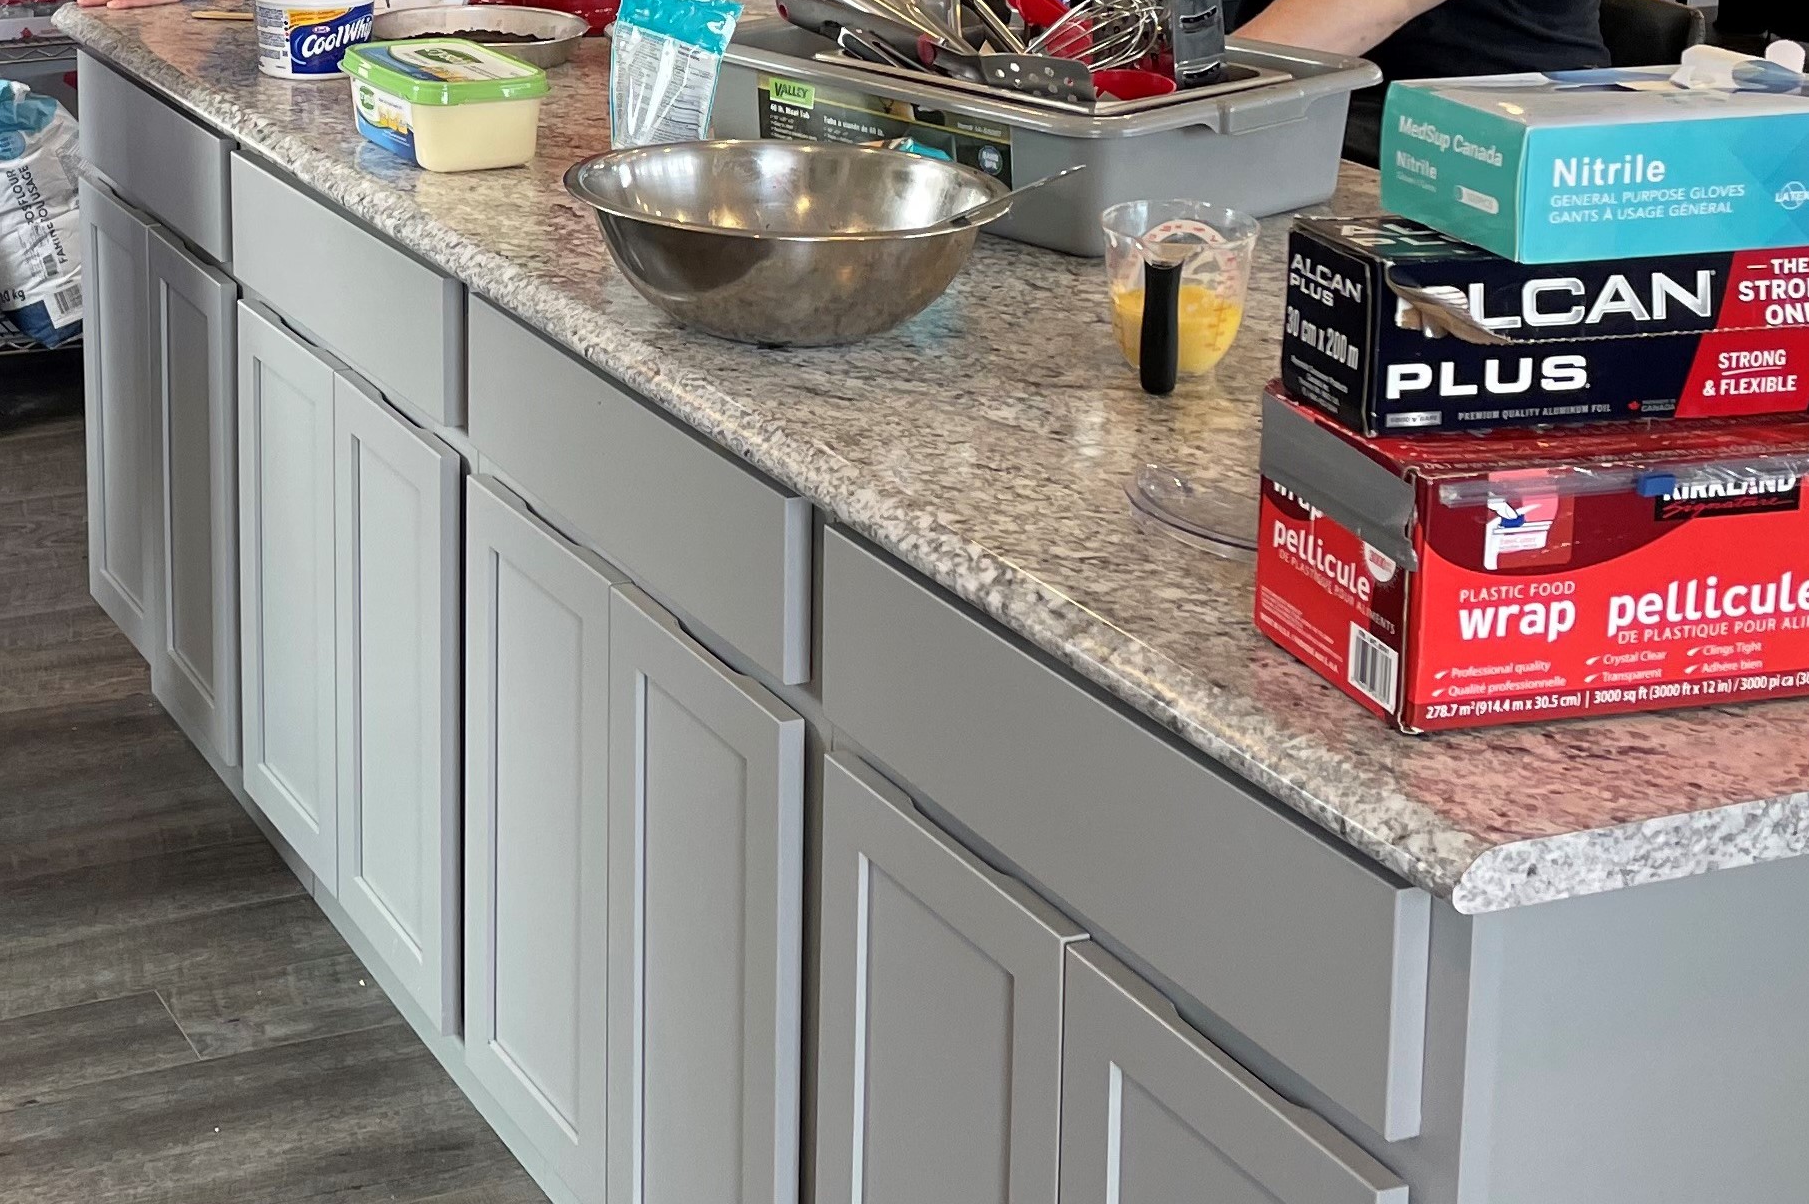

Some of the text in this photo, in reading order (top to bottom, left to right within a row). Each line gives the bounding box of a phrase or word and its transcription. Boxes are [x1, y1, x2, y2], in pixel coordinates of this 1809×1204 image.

[301, 25, 344, 58] Cool
[774, 82, 808, 99] VALLEY
[1399, 115, 1504, 167] MedSup Canada
[1396, 151, 1437, 180] Nitrile
[1553, 154, 1666, 188] Nitrile
[6, 170, 25, 205] FLOUR
[1551, 184, 1745, 208] GENERAL PURPOSE GLOVES
[1549, 209, 1599, 224] GANTS
[1618, 205, 1664, 220] USAGE
[1669, 200, 1734, 217] GÉNÉRAL
[1291, 254, 1362, 303] ALCAN
[1770, 258, 1809, 275] THE
[12, 289, 26, 302] kg
[1290, 272, 1335, 307] PLUS
[1395, 270, 1712, 331] LCAN
[1738, 278, 1809, 302] STRO
[1287, 306, 1359, 370] 30 cm x 200 m
[1718, 349, 1787, 369] STRONG
[1386, 355, 1588, 400] PLUS
[1702, 374, 1797, 396] & FLEXIBLE
[1458, 403, 1611, 421] PREMIUM QUALITY ALUMINUM FOIL
[1273, 519, 1371, 602] pellicule
[1279, 549, 1291, 563] DE
[1291, 554, 1333, 594] PLASTIQUE
[1356, 598, 1396, 635] ALIMENTS
[1460, 581, 1575, 603] PLASTIC FOOD
[1459, 599, 1576, 643] wrap
[1617, 630, 1638, 645] DE
[1644, 622, 1729, 642] PLASTIQUE
[1734, 618, 1776, 634] POUR
[1602, 650, 1667, 666] Crystal Clear
[1702, 641, 1762, 657] Clings Tight
[1451, 660, 1551, 678] Professional quality
[1602, 669, 1662, 683] Transparent
[1740, 659, 1763, 670] bien
[1448, 676, 1567, 696] Qualité professionnelle
[1593, 690, 1621, 705] 3000
[1622, 691, 1636, 704] sq
[1638, 687, 1648, 700] ft
[1649, 684, 1680, 701] (3000
[1682, 683, 1691, 695] ft
[1692, 684, 1700, 694] x
[1702, 681, 1715, 694] 12
[1717, 679, 1732, 693] in)
[1740, 676, 1768, 691] 3000
[1768, 674, 1781, 690] pi
[1782, 676, 1794, 687] ca
[1426, 703, 1458, 719] 278.7
[1512, 699, 1524, 711] m
[1526, 699, 1532, 709] x
[1534, 695, 1558, 709] 30.5
[1560, 692, 1581, 707] cm)
